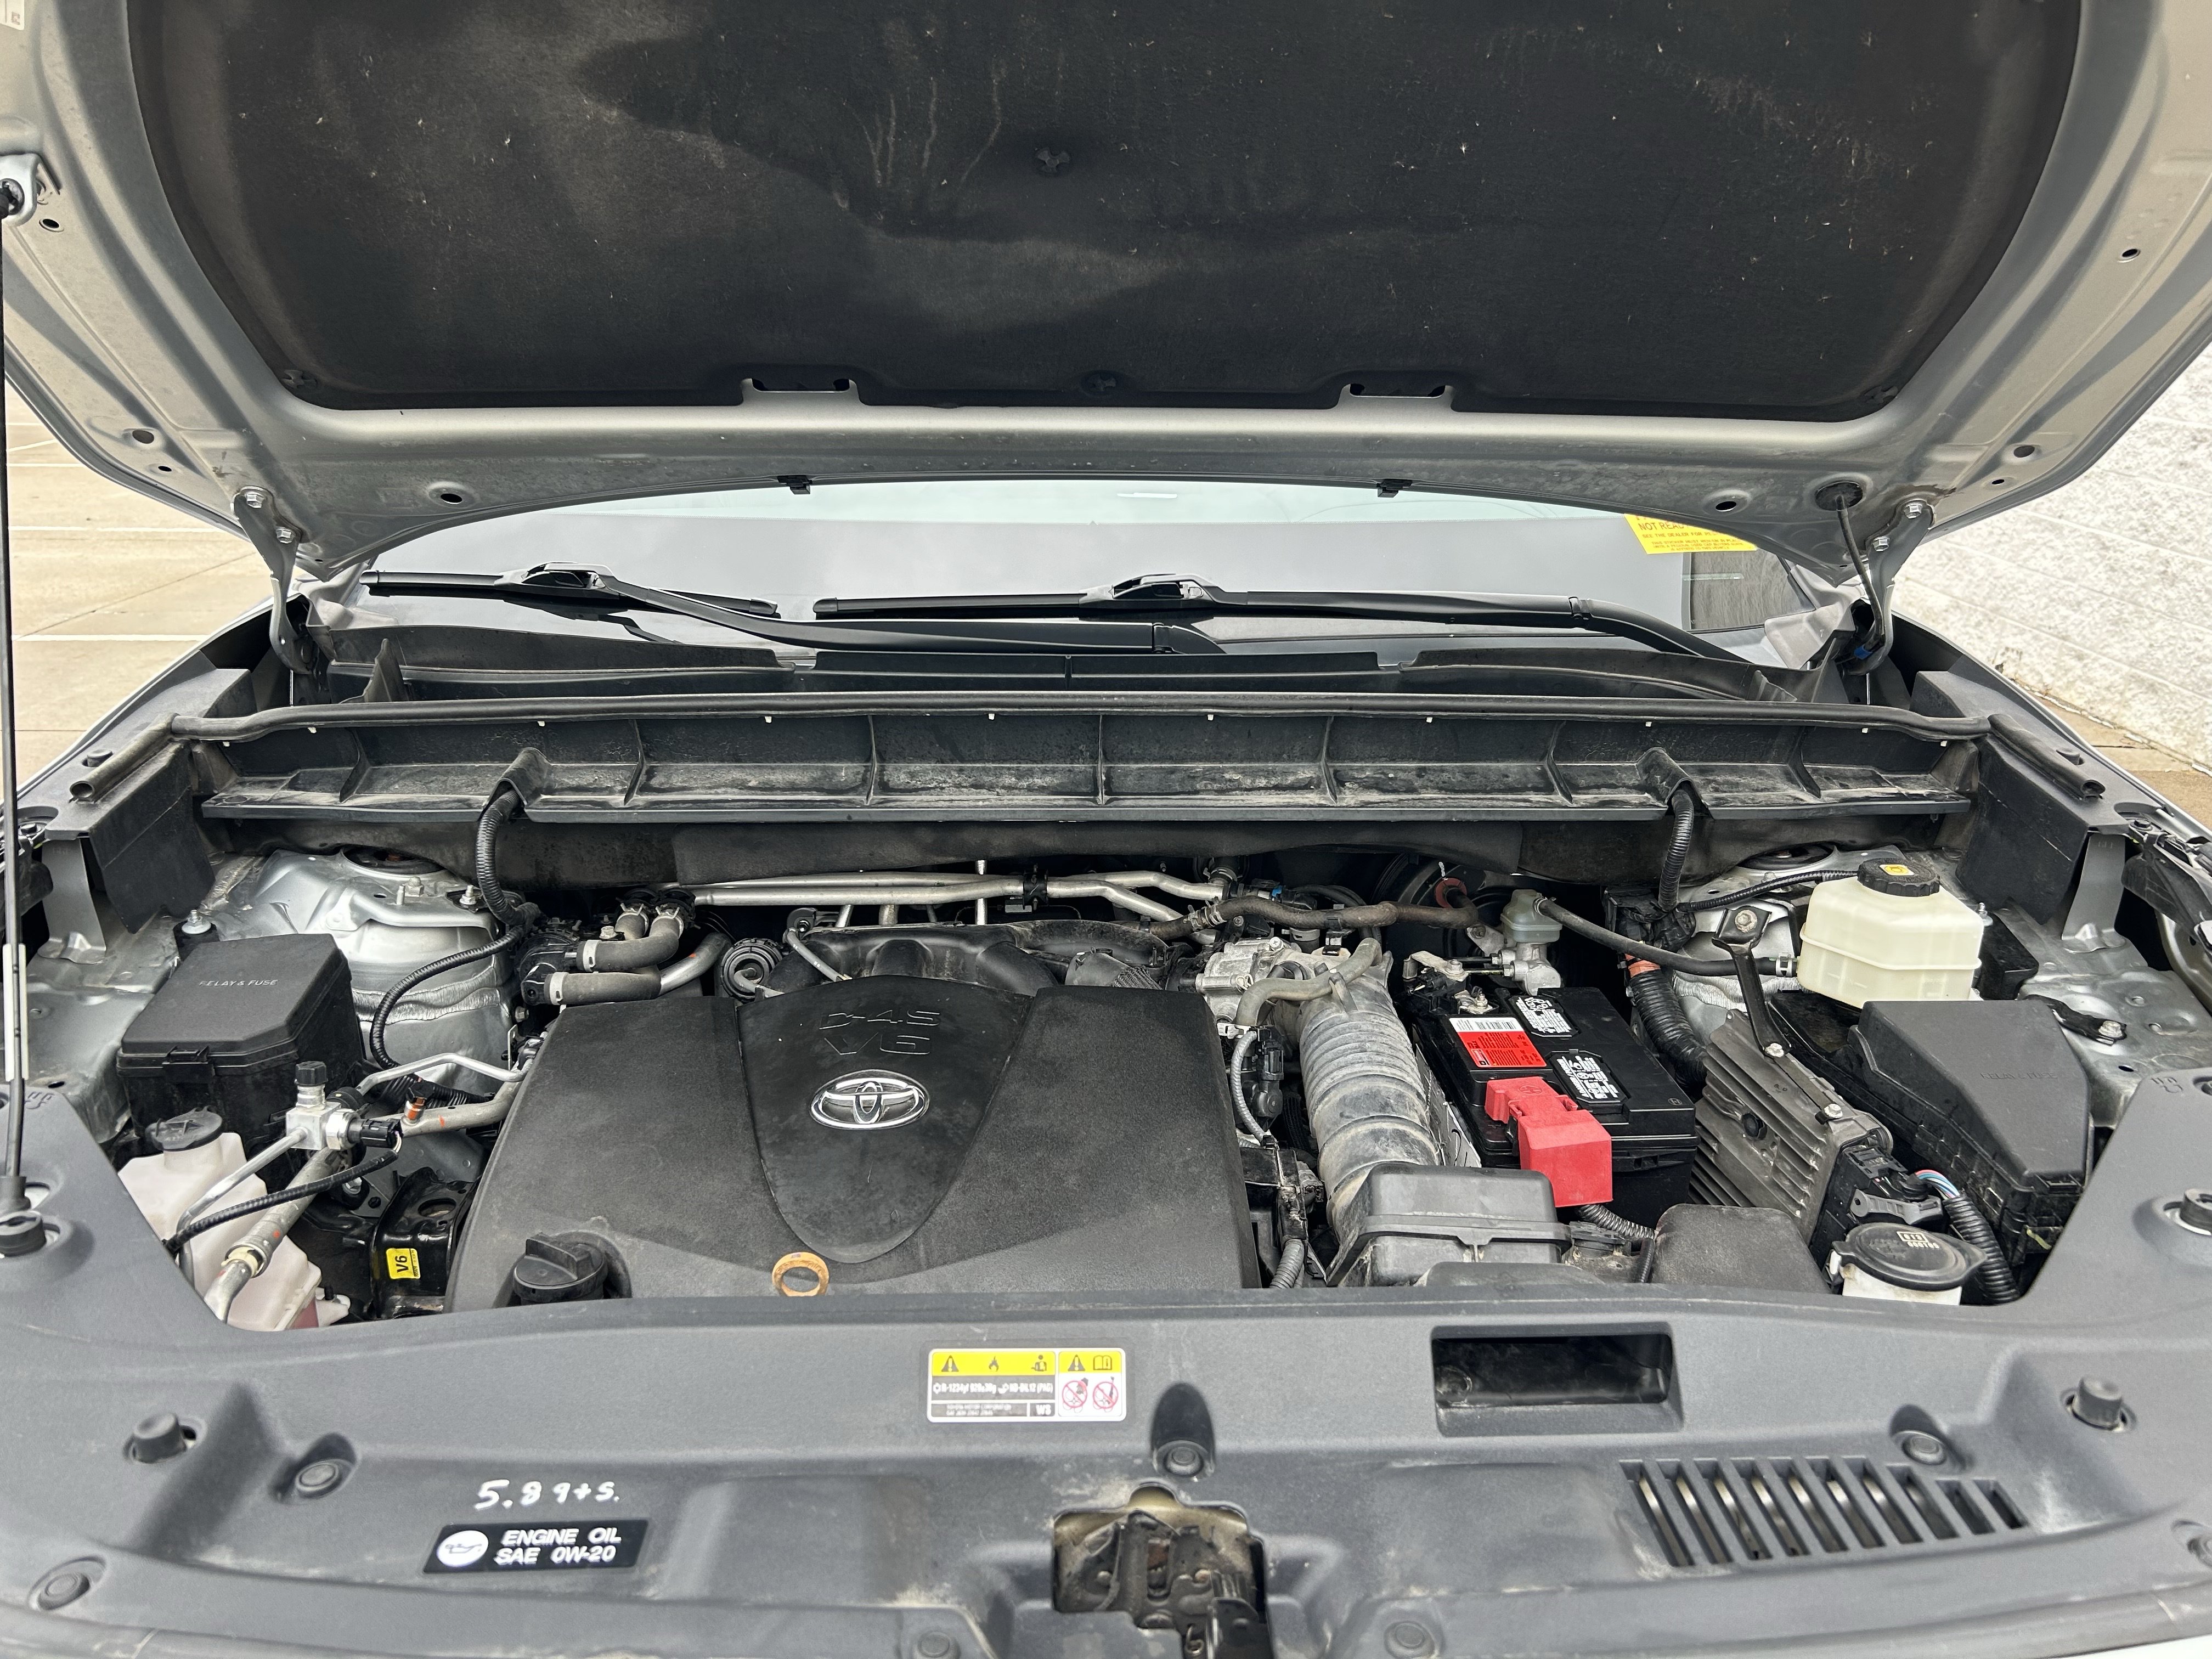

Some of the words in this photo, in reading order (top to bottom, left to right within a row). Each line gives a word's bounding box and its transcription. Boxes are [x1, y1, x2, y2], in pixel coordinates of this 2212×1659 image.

[1638, 522, 1657, 531] NOT
[819, 1009, 940, 1030] D-4S
[824, 1031, 931, 1056] V6
[395, 1255, 409, 1273] V6
[500, 1528, 579, 1547] ENGINE
[588, 1527, 622, 1544] OIL
[494, 1547, 541, 1565] SAE
[550, 1545, 616, 1564] 0W-20
